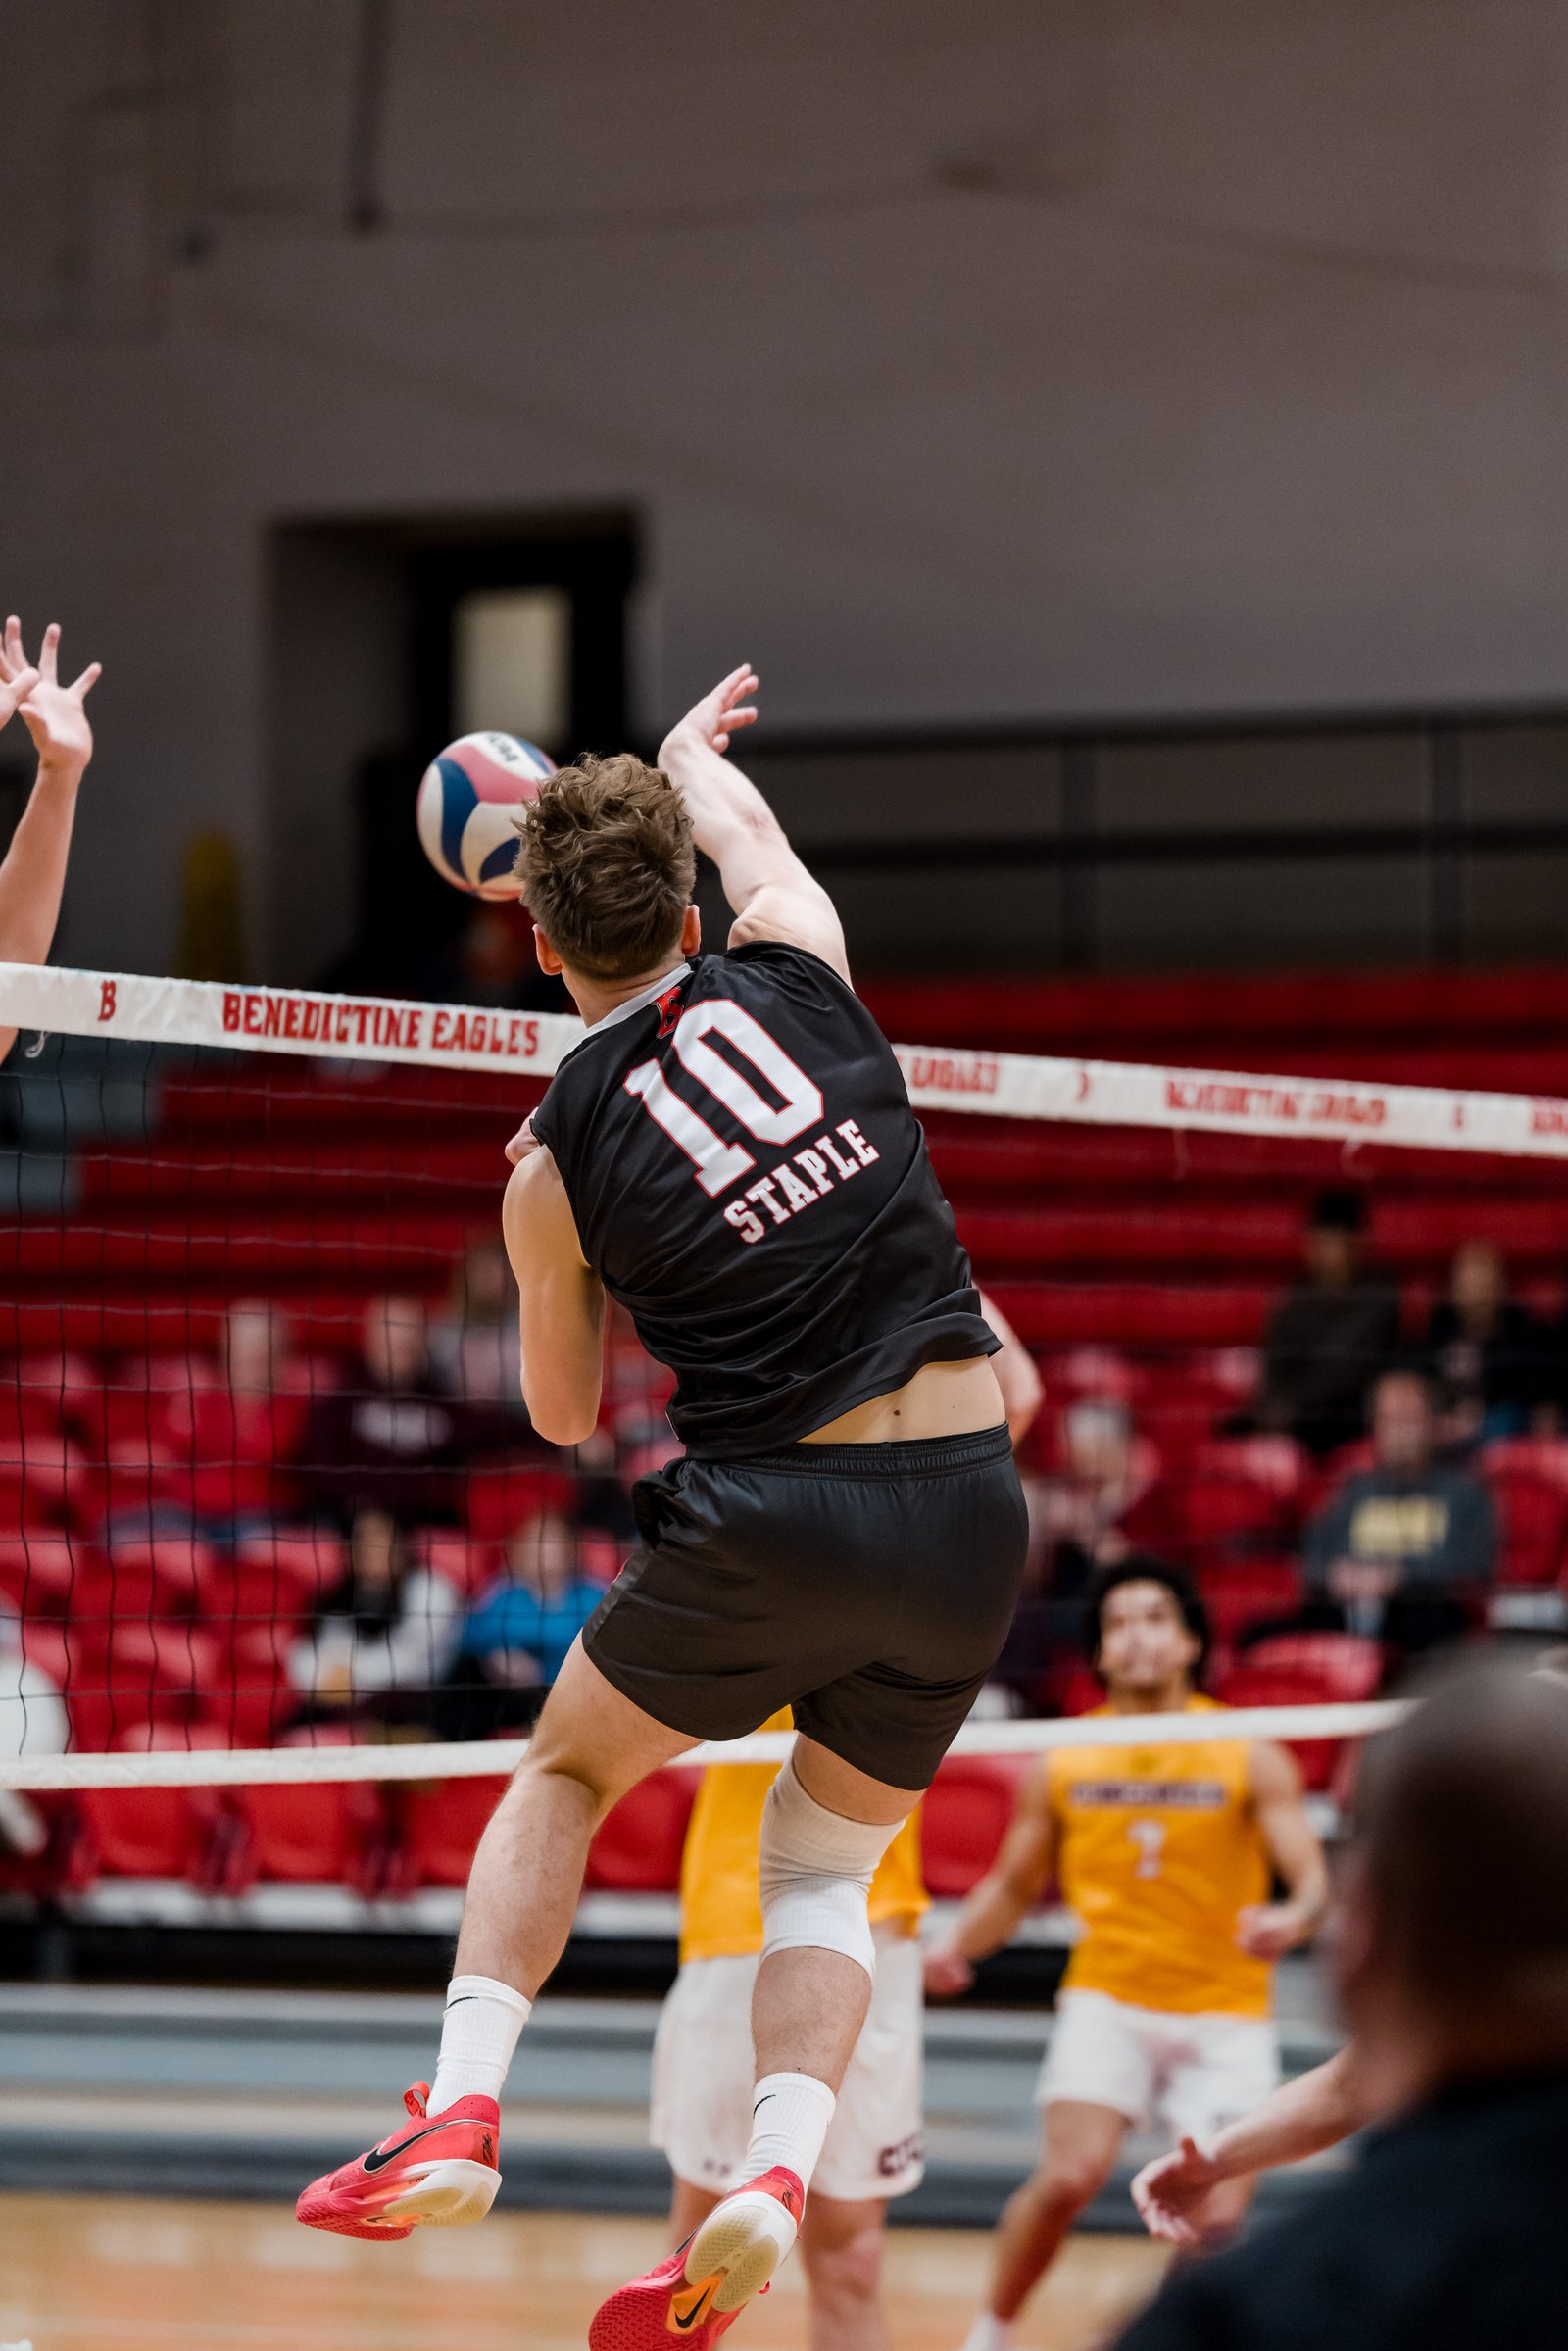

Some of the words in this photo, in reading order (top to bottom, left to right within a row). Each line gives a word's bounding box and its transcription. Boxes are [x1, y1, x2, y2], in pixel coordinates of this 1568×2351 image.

[98, 980, 117, 1021] B
[223, 992, 421, 1048] BENEDICTINE
[431, 1010, 539, 1056] EAGLES
[622, 999, 824, 1199] 10
[723, 1118, 880, 1244] STAPLE
